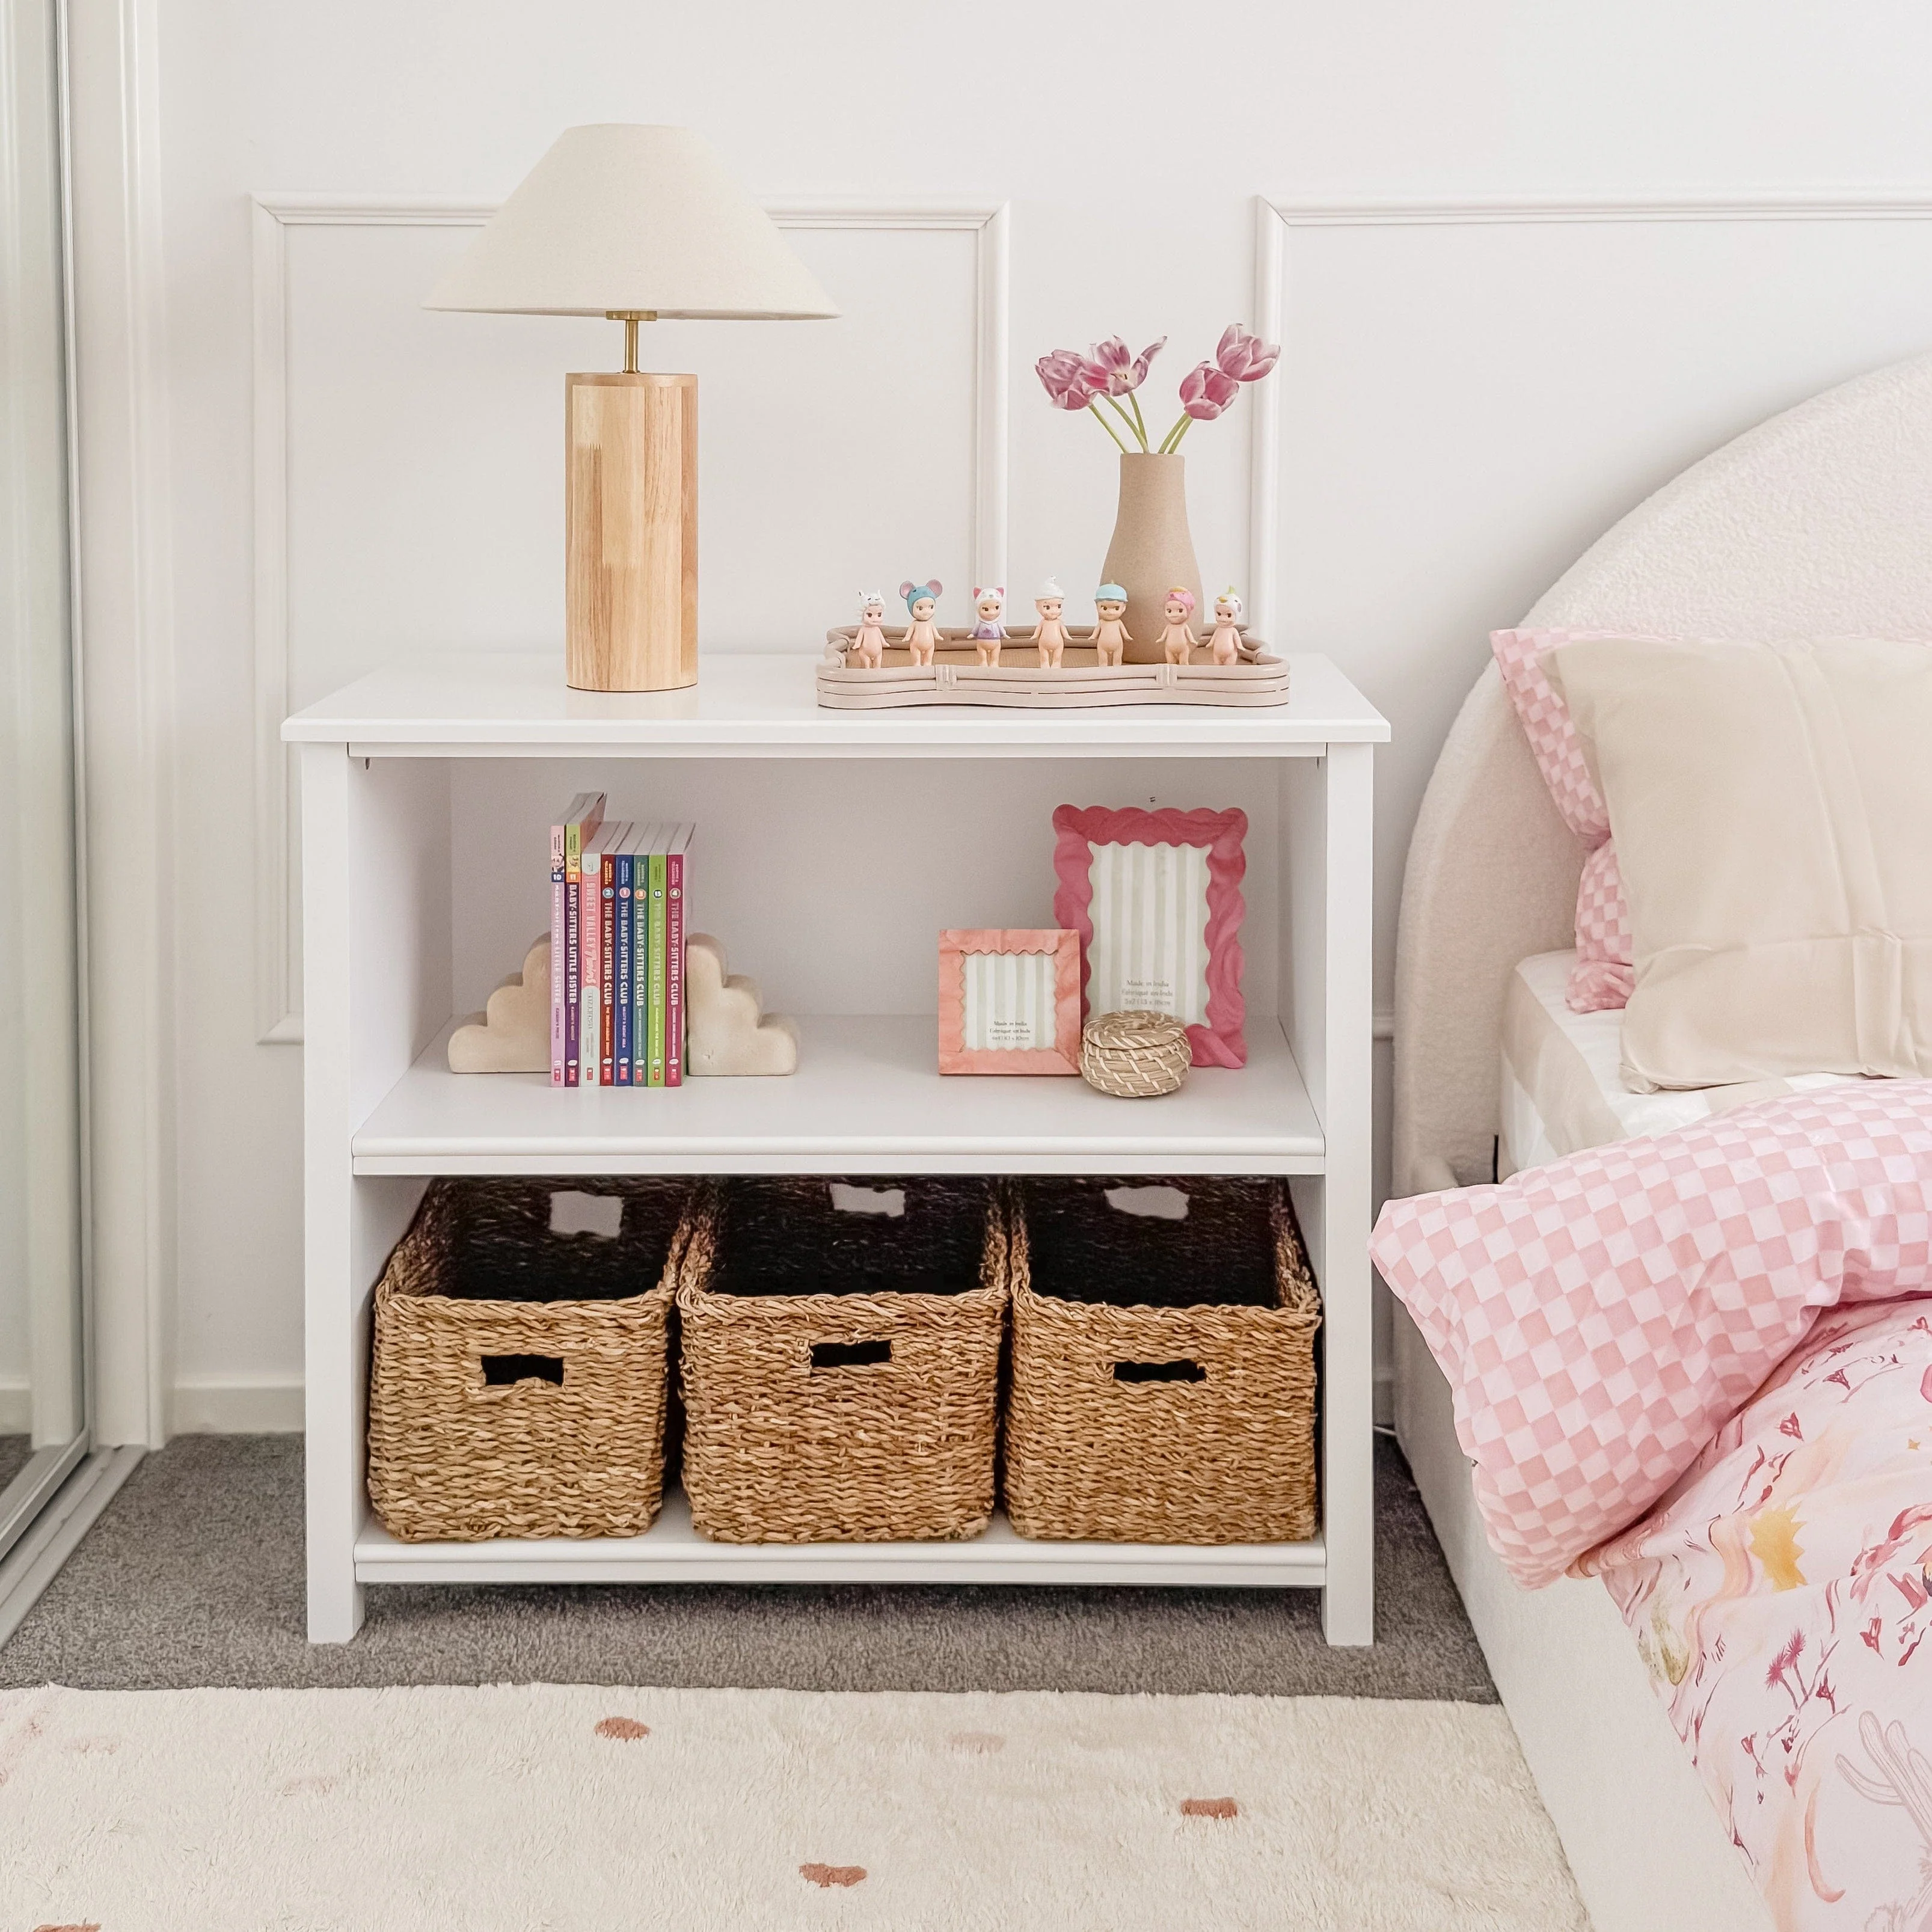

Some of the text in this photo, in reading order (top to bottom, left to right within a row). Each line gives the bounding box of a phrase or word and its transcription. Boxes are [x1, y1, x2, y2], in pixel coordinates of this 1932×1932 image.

[585, 883, 596, 912] SWEET
[569, 885, 577, 1003] BABY-SITTERS LITTLE SISTER
[586, 916, 596, 947] VALLEY
[584, 950, 597, 984] Twins
[670, 903, 679, 1005] THE BABY-SITTERS CLUB
[636, 983, 645, 1007] CLUB
